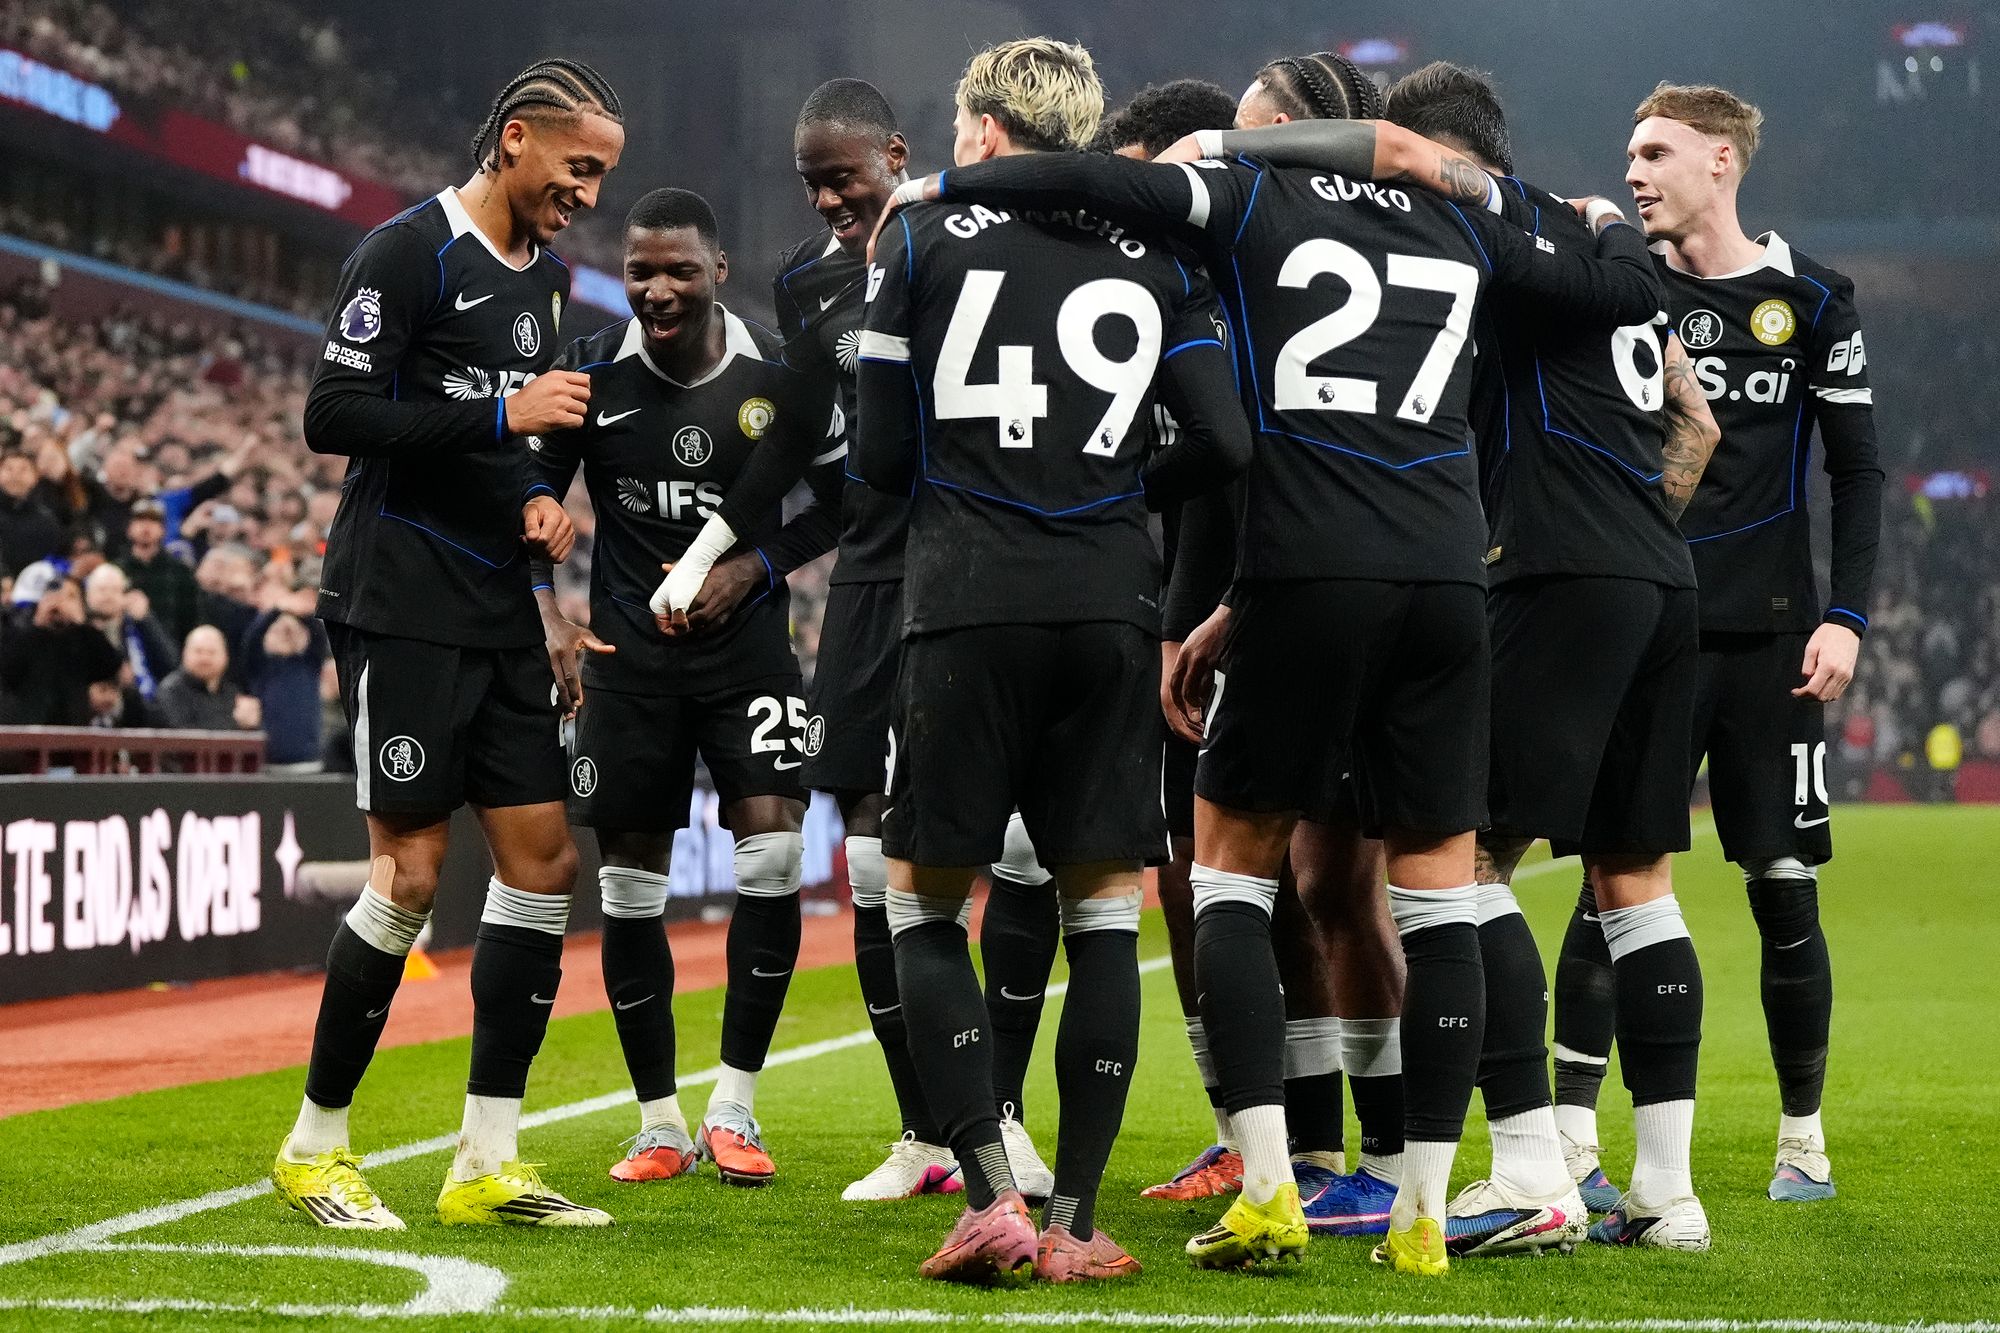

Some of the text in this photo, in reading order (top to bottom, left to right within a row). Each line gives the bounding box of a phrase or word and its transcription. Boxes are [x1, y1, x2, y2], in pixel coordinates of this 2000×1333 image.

[1274, 238, 1479, 424] 27
[1761, 332, 1778, 342] FIFA
[324, 351, 372, 373] for racism
[327, 341, 370, 363] No room
[933, 269, 1162, 457] 49
[1691, 356, 1796, 404] S.ai
[657, 481, 724, 520] IFS
[747, 695, 808, 754] 25
[1657, 983, 1688, 995] CFC
[1438, 1016, 1469, 1028] CFC
[953, 1028, 980, 1049] CFC
[1095, 1059, 1122, 1077] CFC
